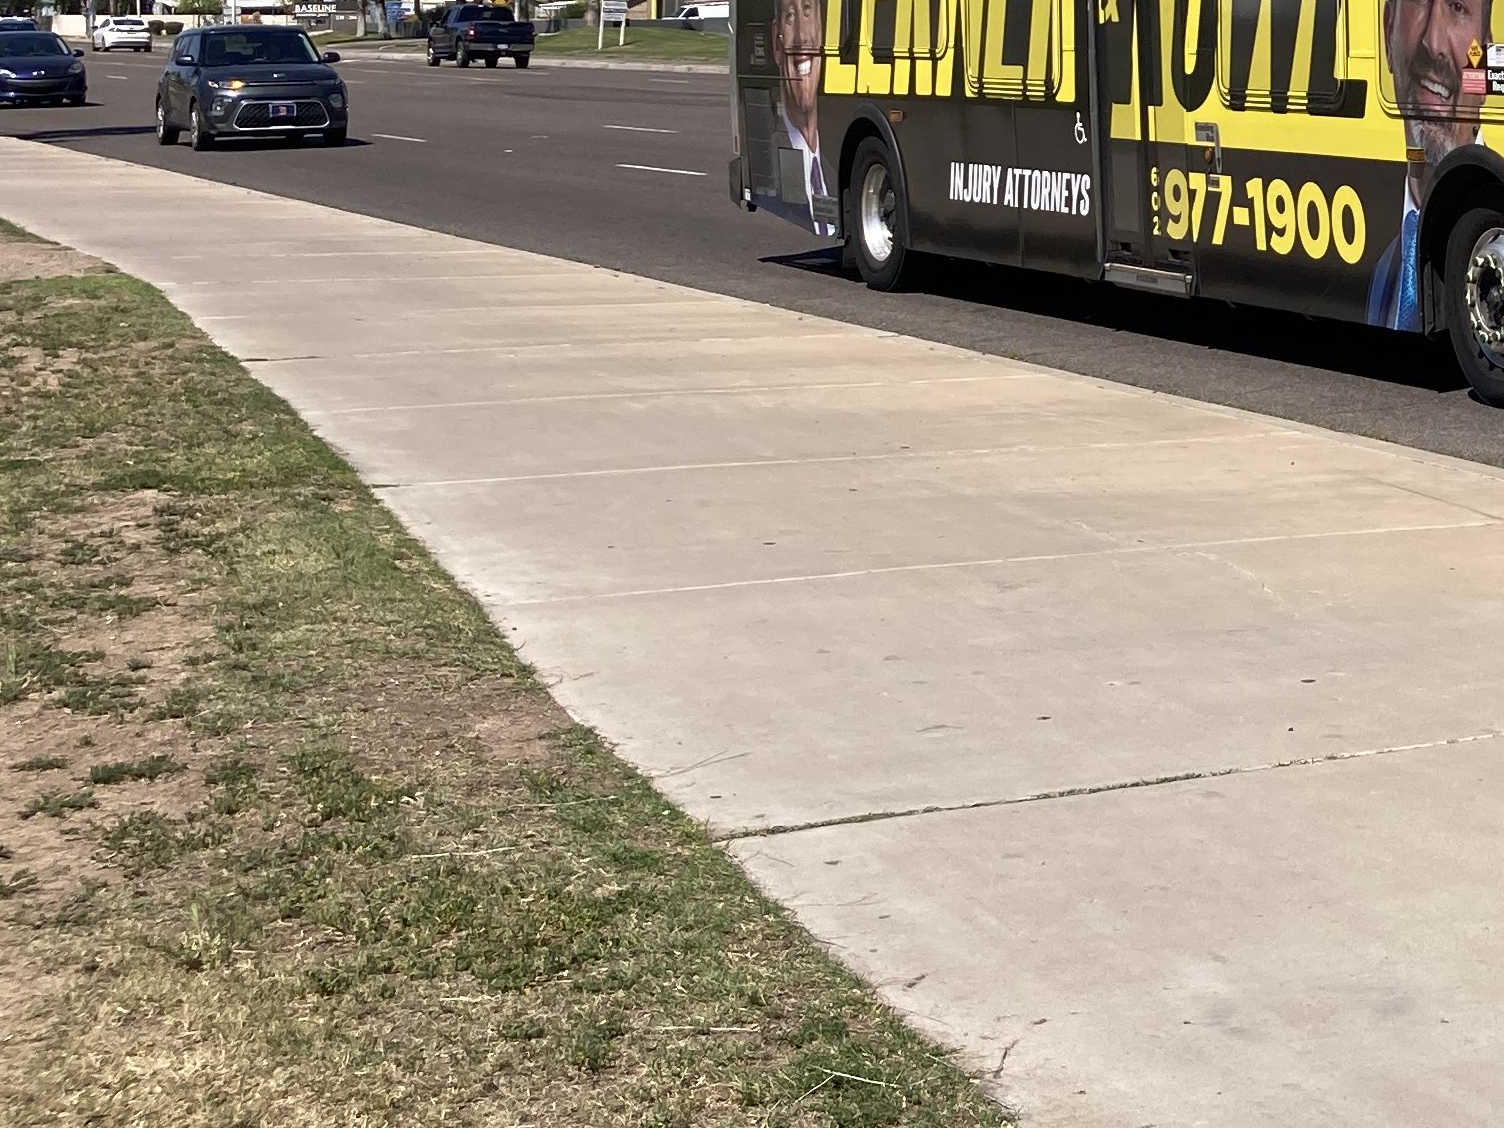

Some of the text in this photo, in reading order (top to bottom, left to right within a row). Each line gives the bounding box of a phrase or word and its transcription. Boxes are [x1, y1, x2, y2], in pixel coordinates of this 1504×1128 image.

[294, 4, 337, 13] BASELINE
[1487, 69, 1504, 81] Exact
[950, 161, 1091, 217] INJURY ATTORNEYS
[1150, 166, 1161, 236] 602
[1164, 168, 1366, 265] 977-1900
